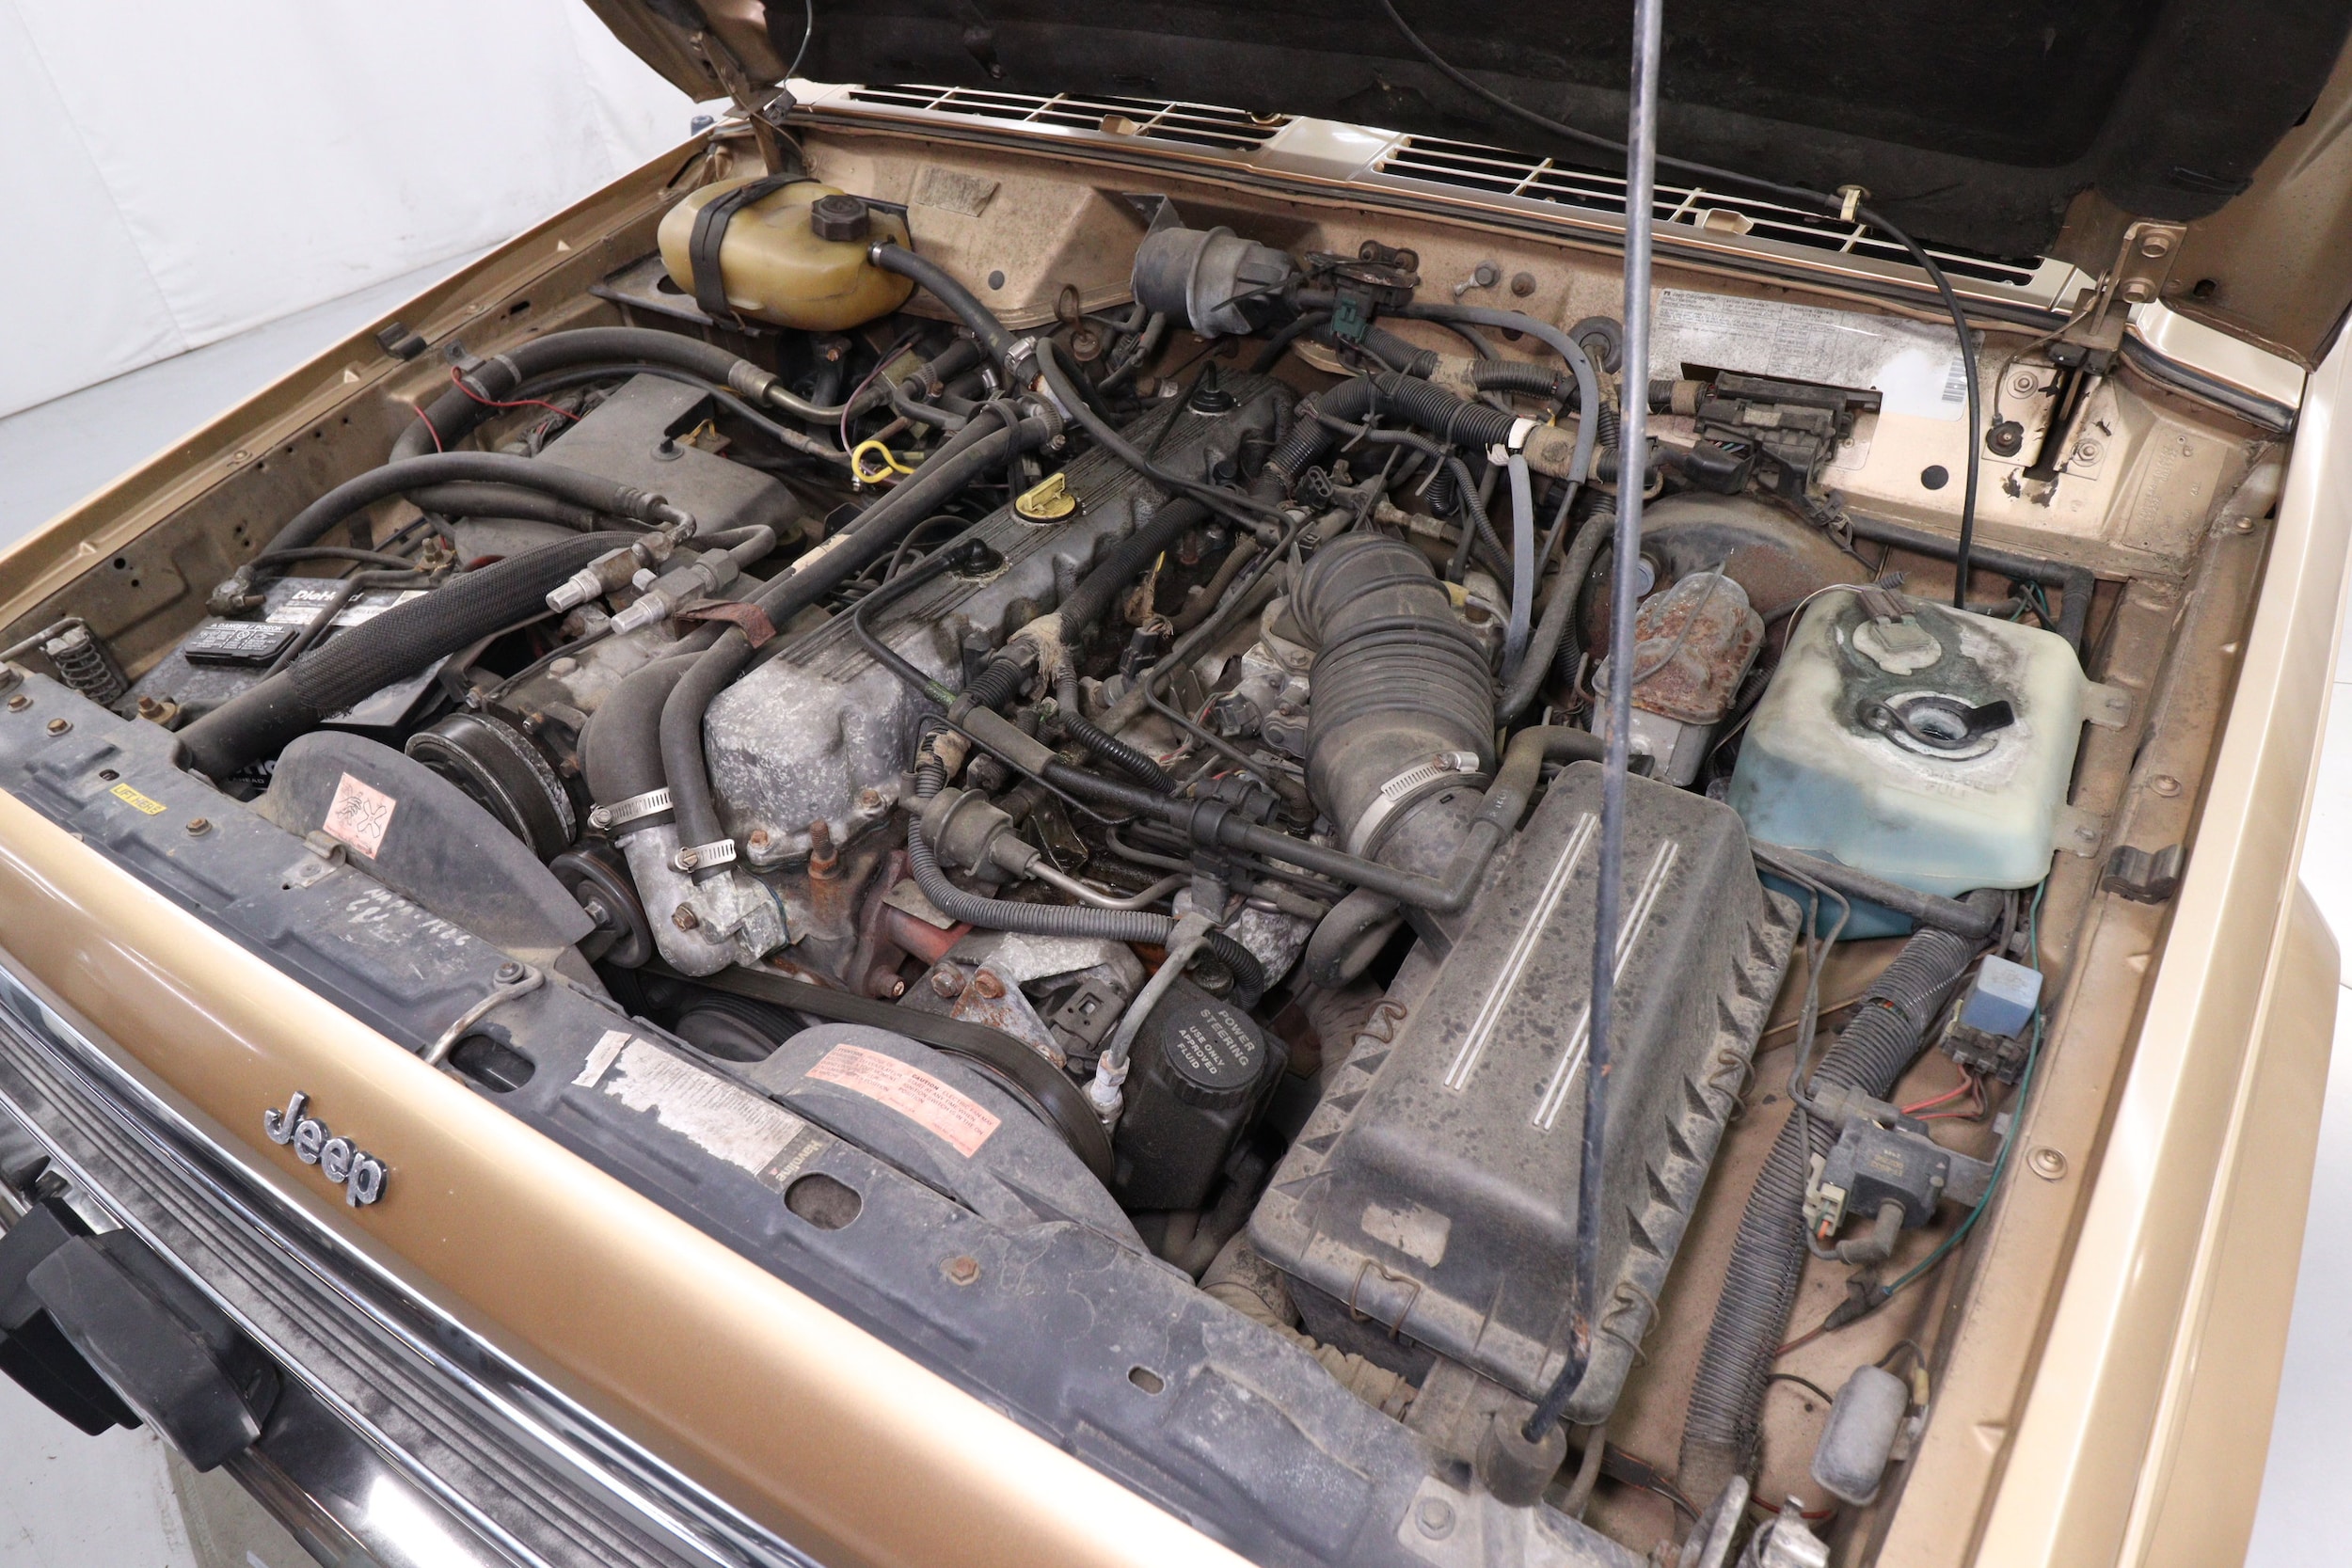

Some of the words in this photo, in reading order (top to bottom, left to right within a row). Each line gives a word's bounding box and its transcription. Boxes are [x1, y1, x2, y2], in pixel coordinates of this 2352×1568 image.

[114, 785, 137, 800] LIFT
[132, 797, 162, 814] HERE
[1179, 1029, 1217, 1074] APPROVED
[1189, 1025, 1206, 1044] USE
[1204, 1043, 1225, 1067] ONLY
[1200, 1008, 1248, 1067] STEERING
[1217, 1009, 1256, 1052] POWER
[1177, 1042, 1200, 1069] FLUID
[928, 1097, 949, 1111] SWITCH
[932, 1092, 944, 1101] ANY
[945, 1099, 957, 1109] TIME
[958, 1108, 976, 1122] WHEN
[969, 1107, 981, 1117] FAN
[263, 1091, 388, 1208] Jeep
[774, 1139, 824, 1182] Havoline
